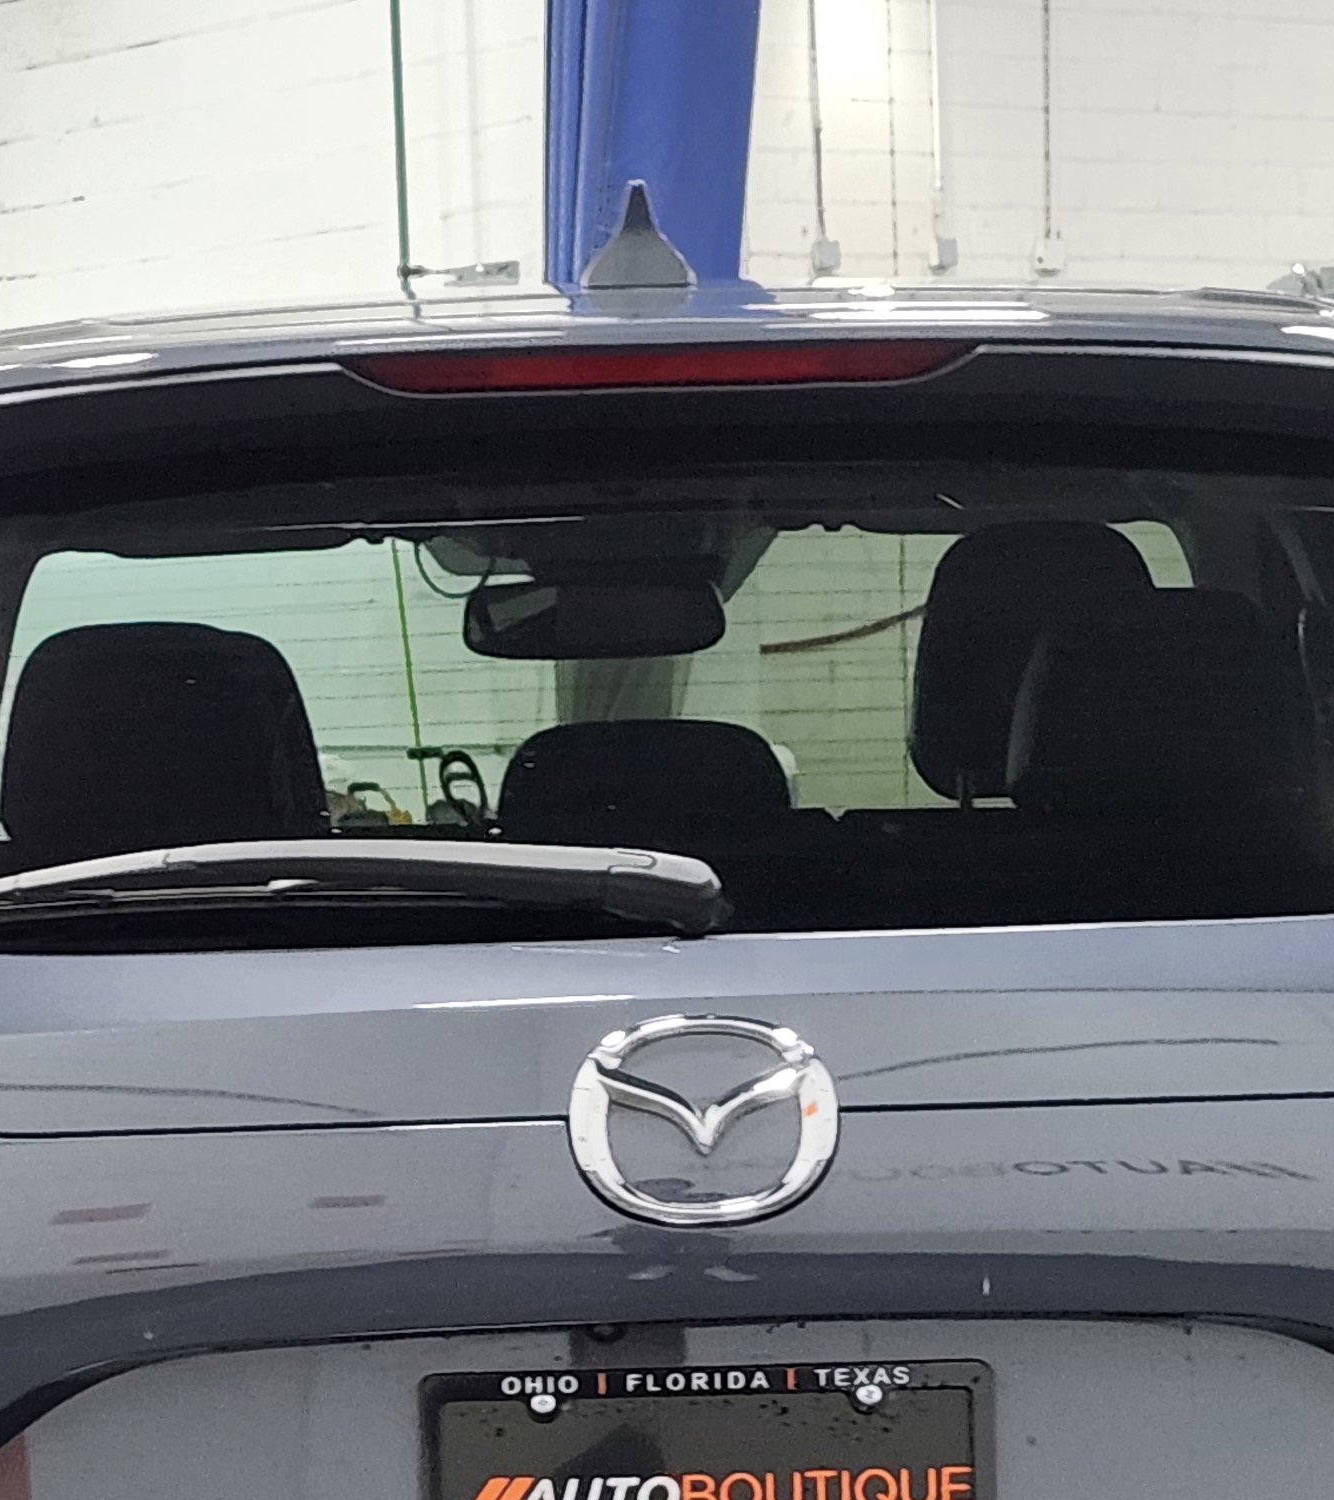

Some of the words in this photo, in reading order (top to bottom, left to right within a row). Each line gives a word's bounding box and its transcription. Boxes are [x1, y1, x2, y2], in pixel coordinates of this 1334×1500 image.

[500, 1375, 579, 1395] OHIO
[624, 1370, 770, 1392] FLORIDA
[814, 1366, 911, 1388] TEXAS
